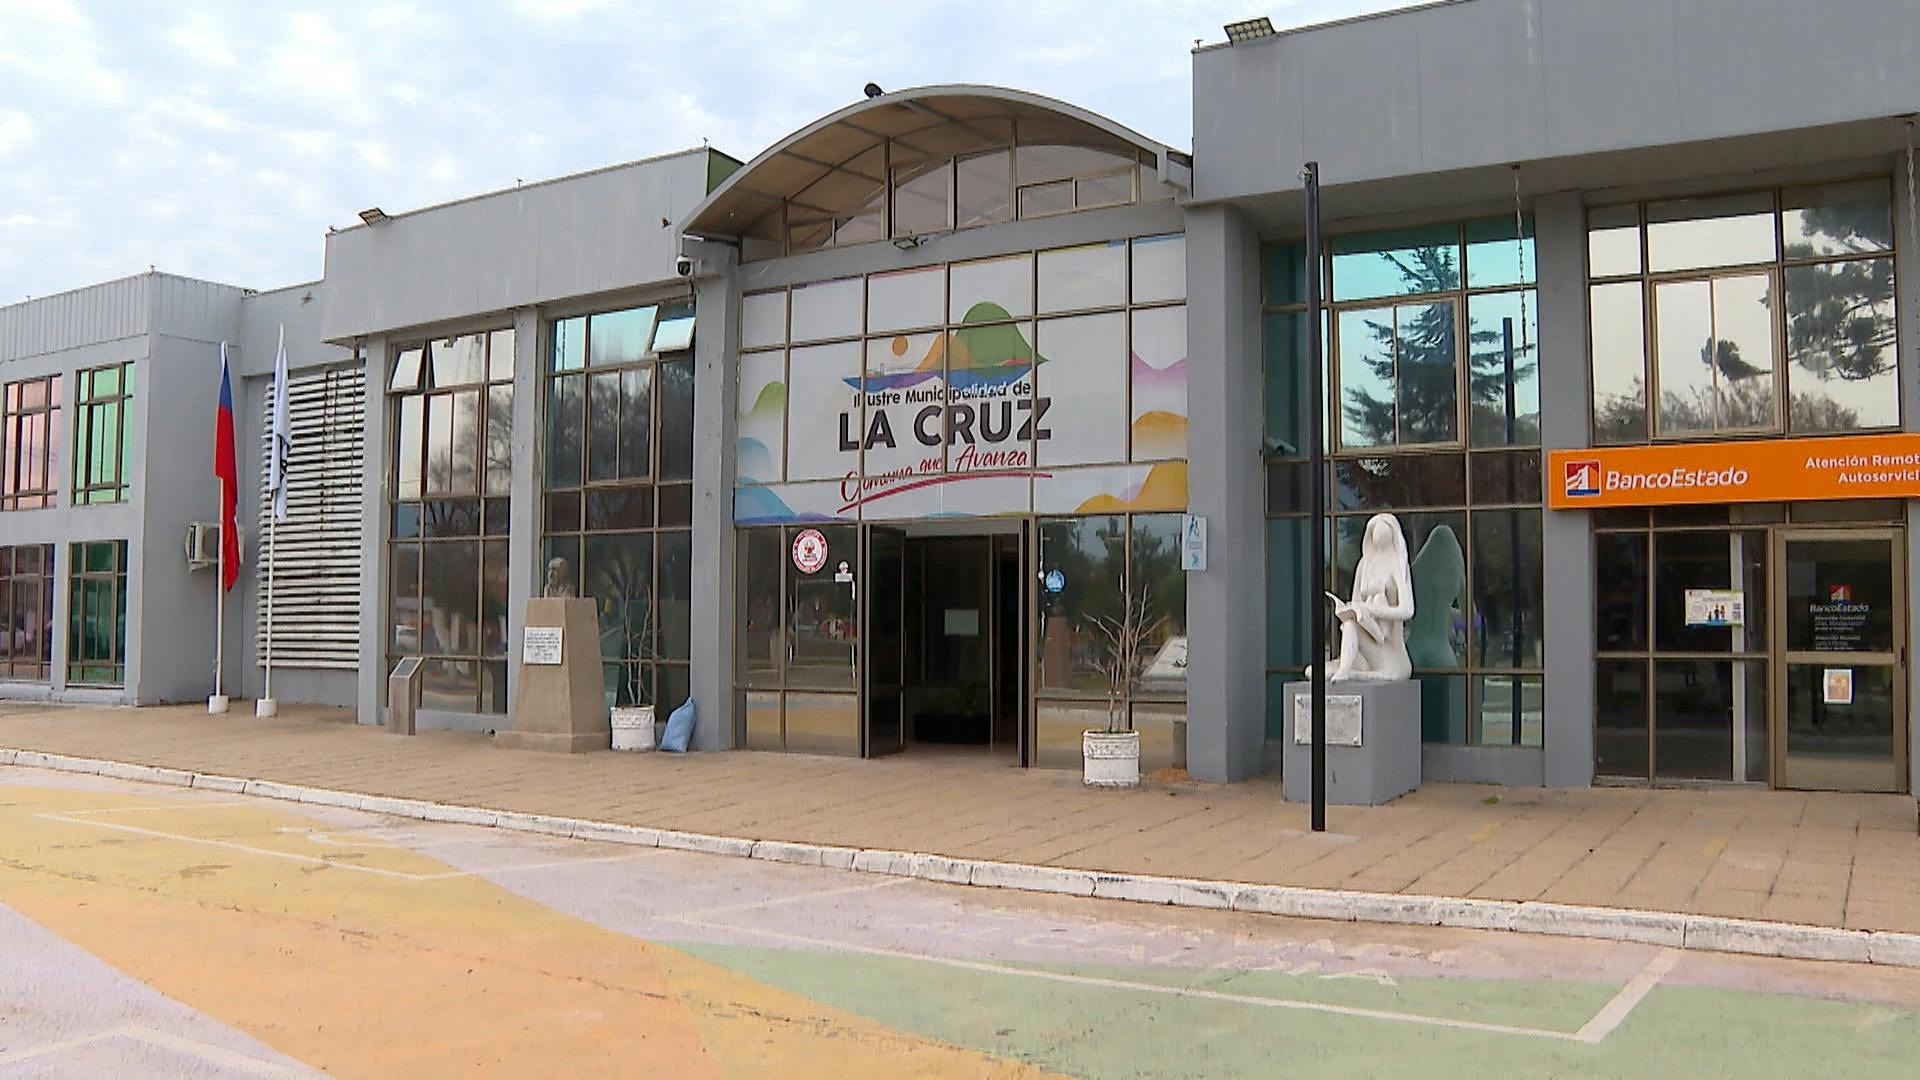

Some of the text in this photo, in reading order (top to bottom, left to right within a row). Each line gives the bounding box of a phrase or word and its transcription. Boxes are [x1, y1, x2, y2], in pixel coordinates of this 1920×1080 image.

[905, 381, 1007, 404] Municipalidad
[1012, 381, 1031, 395] de
[839, 397, 1052, 452] LA CRUZ
[841, 443, 1028, 502] Comuna que Avanza
[1805, 454, 1868, 469] Atención
[1604, 466, 1748, 491] BancoEstado
